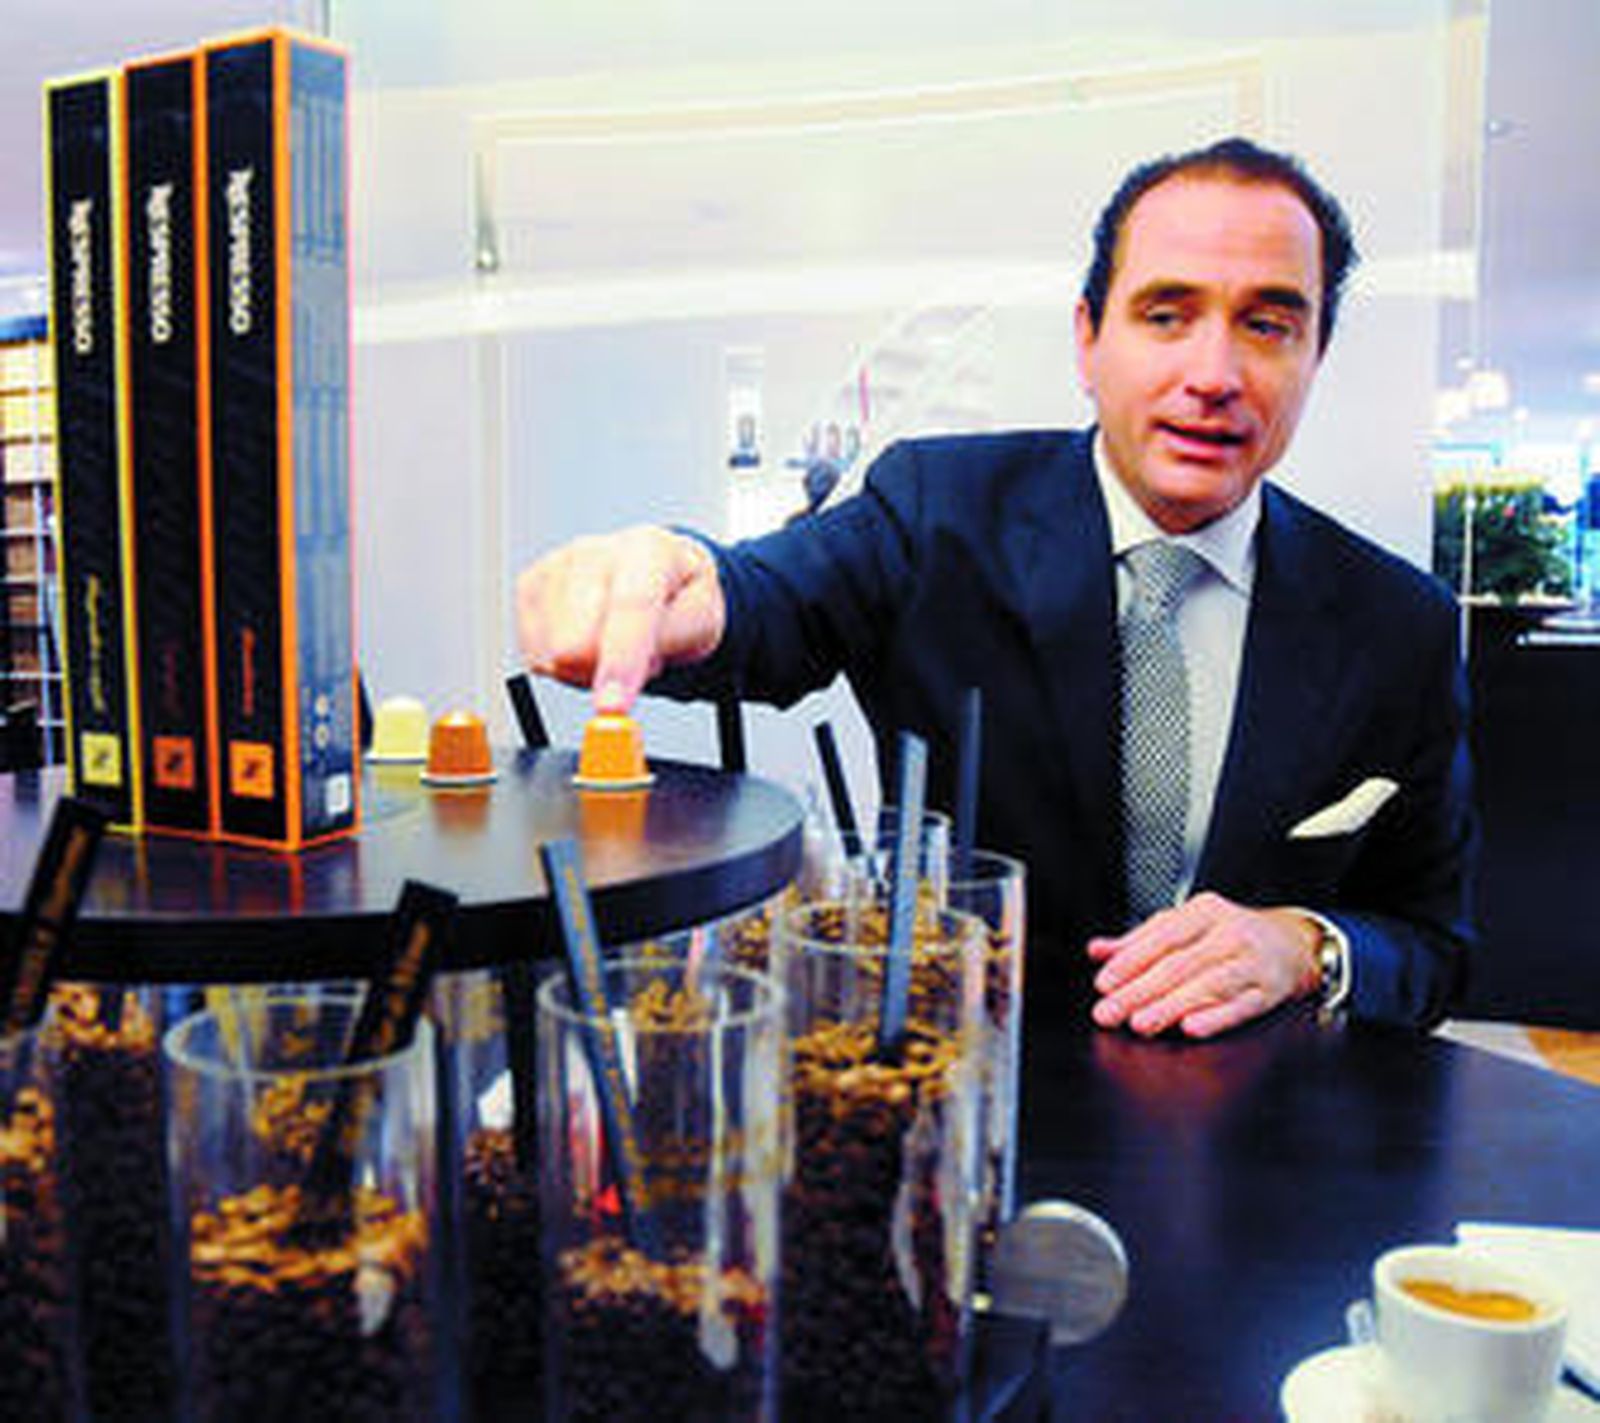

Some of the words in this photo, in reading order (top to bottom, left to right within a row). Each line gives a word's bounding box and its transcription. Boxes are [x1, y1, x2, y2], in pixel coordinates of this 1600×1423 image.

[68, 199, 93, 354] NESPRESSO
[146, 183, 173, 343] NESPRESSO
[225, 167, 253, 335] NESPRESSO
